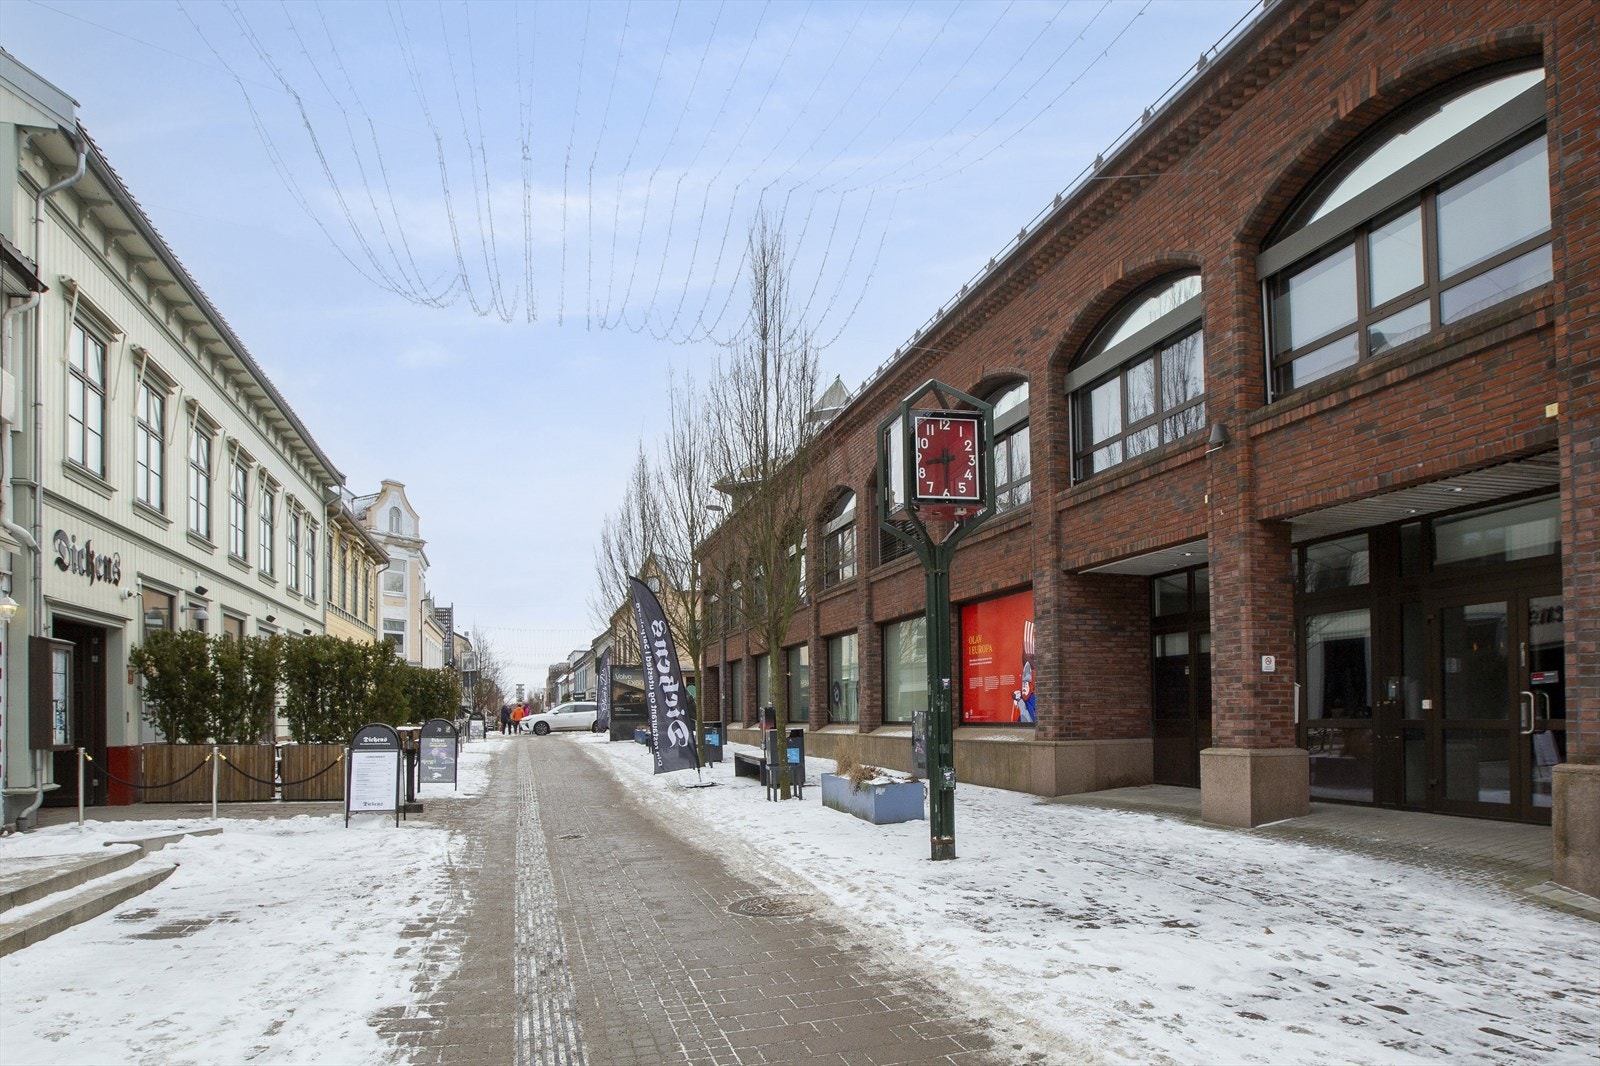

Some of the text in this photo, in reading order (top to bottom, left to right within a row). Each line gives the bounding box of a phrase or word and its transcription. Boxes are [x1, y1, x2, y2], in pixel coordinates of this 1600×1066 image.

[926, 424, 934, 435] 11
[940, 419, 951, 430] 12
[959, 426, 963, 438] 1
[917, 437, 929, 449] 10
[964, 440, 973, 451] 2
[968, 455, 976, 466] 3
[918, 467, 926, 479] 8
[964, 469, 973, 480] 4
[926, 481, 934, 493] 7
[958, 482, 966, 494] 5
[943, 489, 951, 497] 6
[53, 529, 122, 587] Dickens
[972, 644, 992, 654] EUROPA
